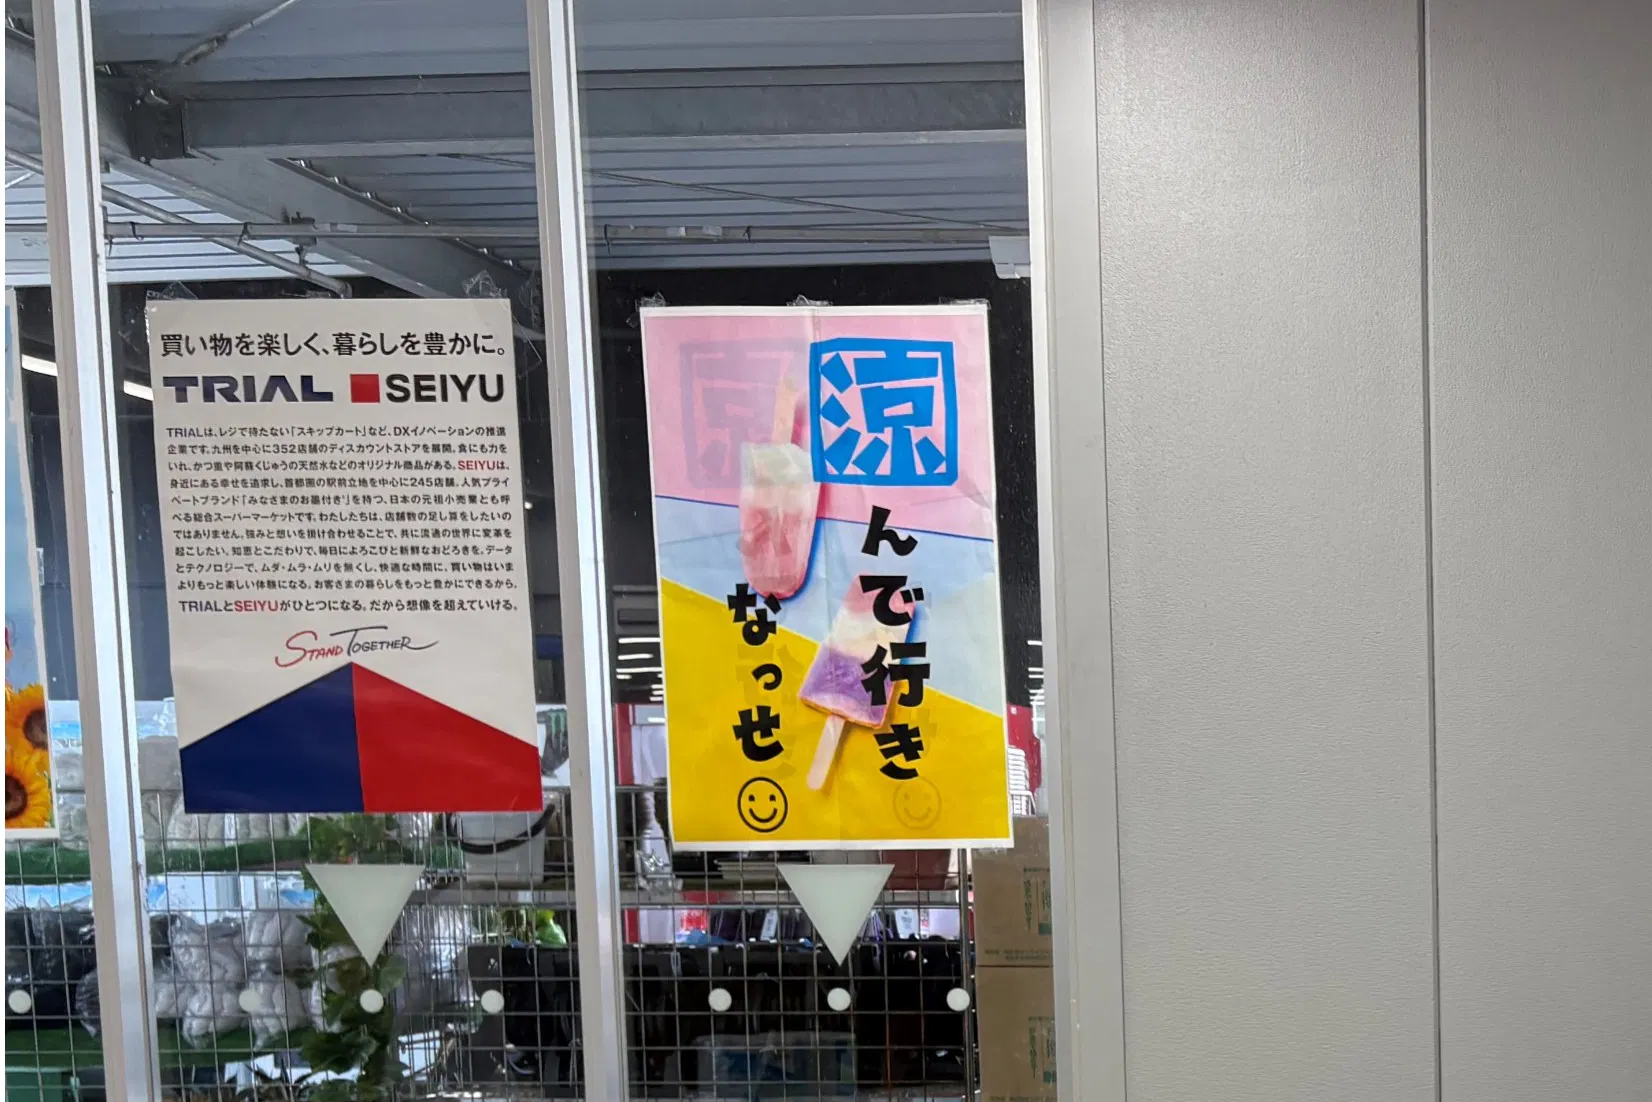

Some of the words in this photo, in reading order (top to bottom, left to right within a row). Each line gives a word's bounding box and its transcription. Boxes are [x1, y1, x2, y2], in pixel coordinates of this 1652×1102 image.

[160, 332, 505, 357] 買い物を楽しく、暮らしを豊かに。
[163, 375, 334, 403] TRIAL
[386, 373, 505, 403] SEIYU
[812, 338, 957, 486] 涼
[727, 582, 784, 762] なっせ
[860, 505, 931, 780] んで行き
